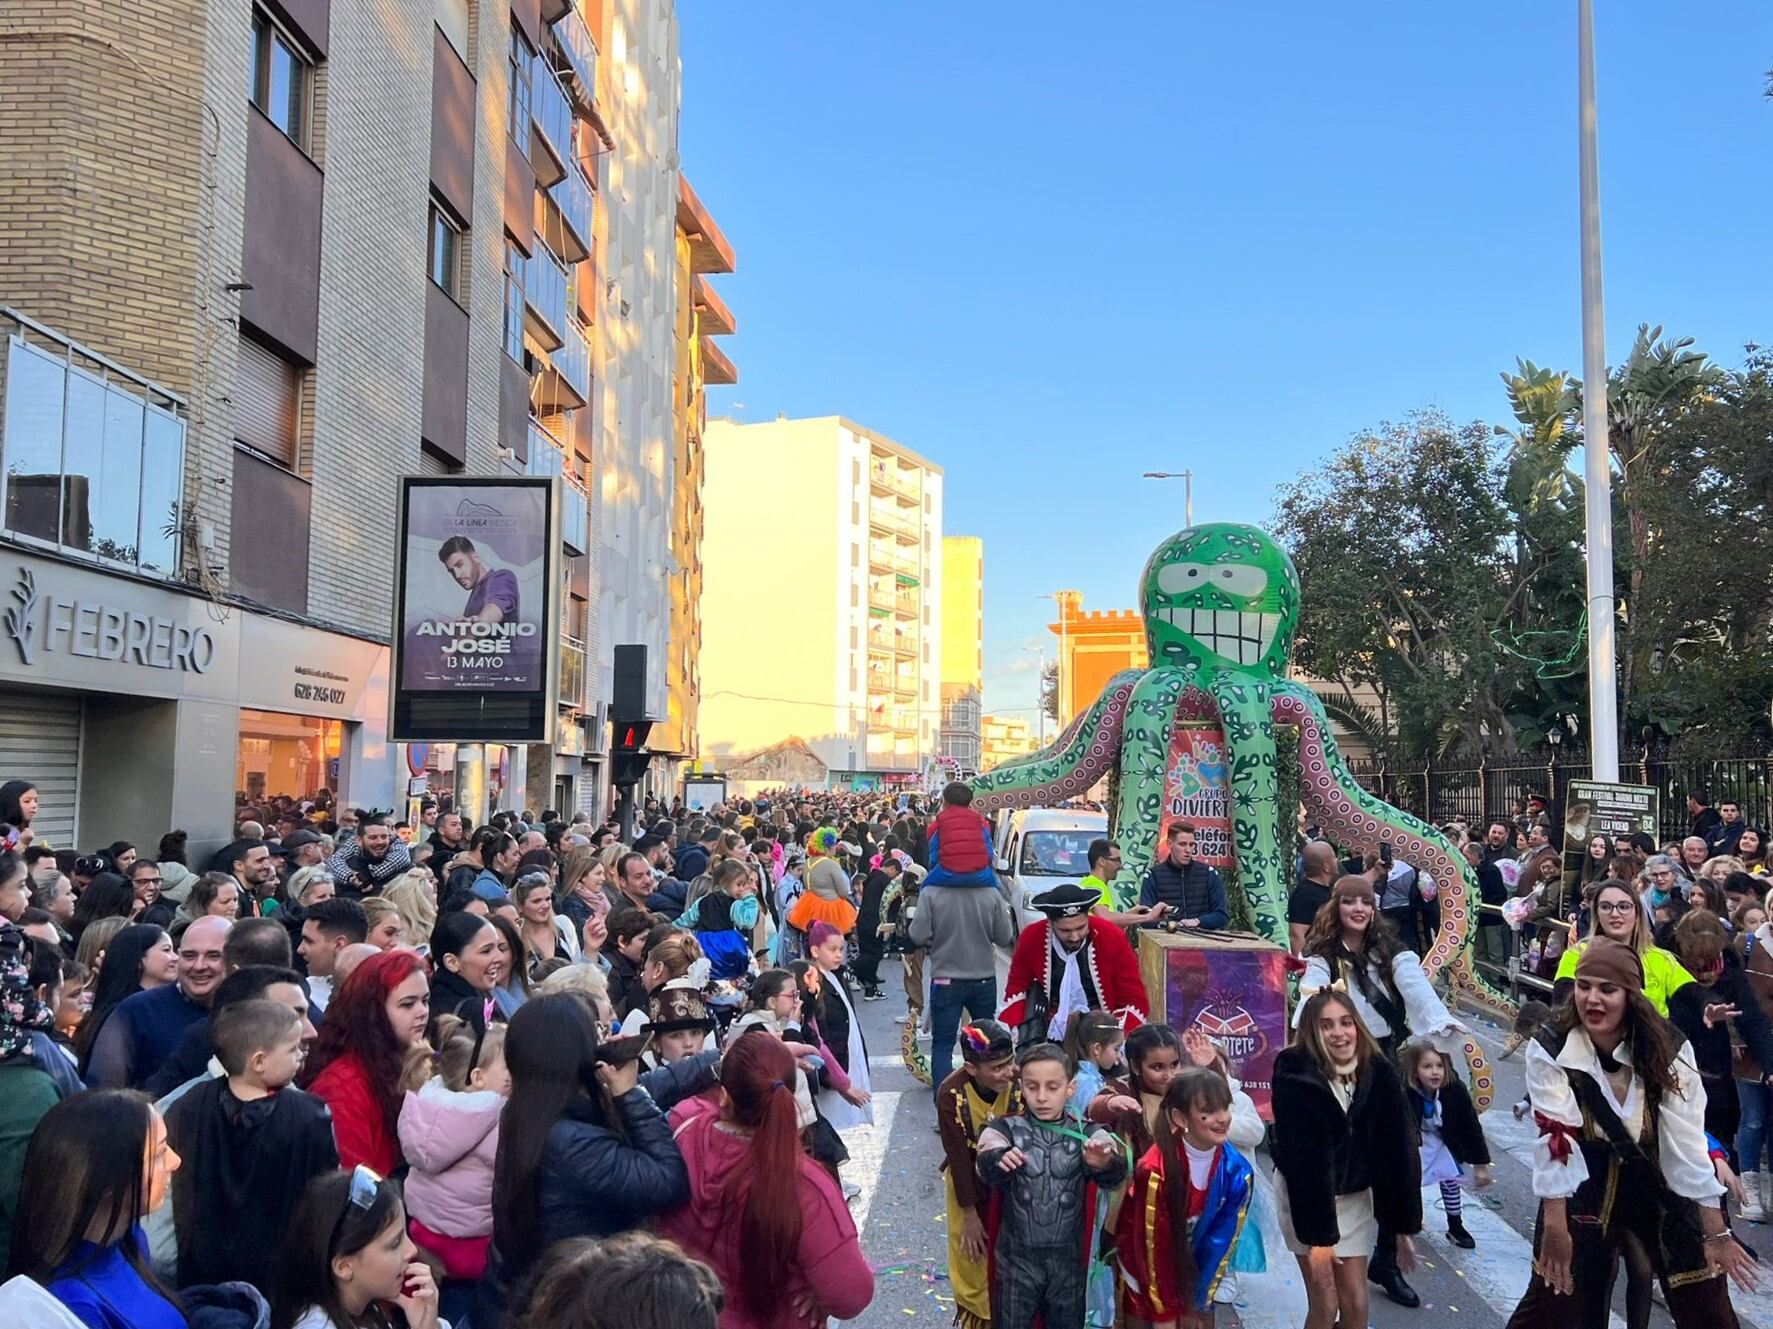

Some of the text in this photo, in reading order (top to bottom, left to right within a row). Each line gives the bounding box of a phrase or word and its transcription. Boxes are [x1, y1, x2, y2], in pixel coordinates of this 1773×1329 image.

[46, 596, 216, 674] FEBRERO
[416, 621, 537, 636] ANTONIO
[441, 636, 511, 653] JOSÉ
[447, 656, 504, 668] 13 MAYO
[1199, 787, 1228, 800] GRUPO
[1202, 842, 1226, 856] 624
